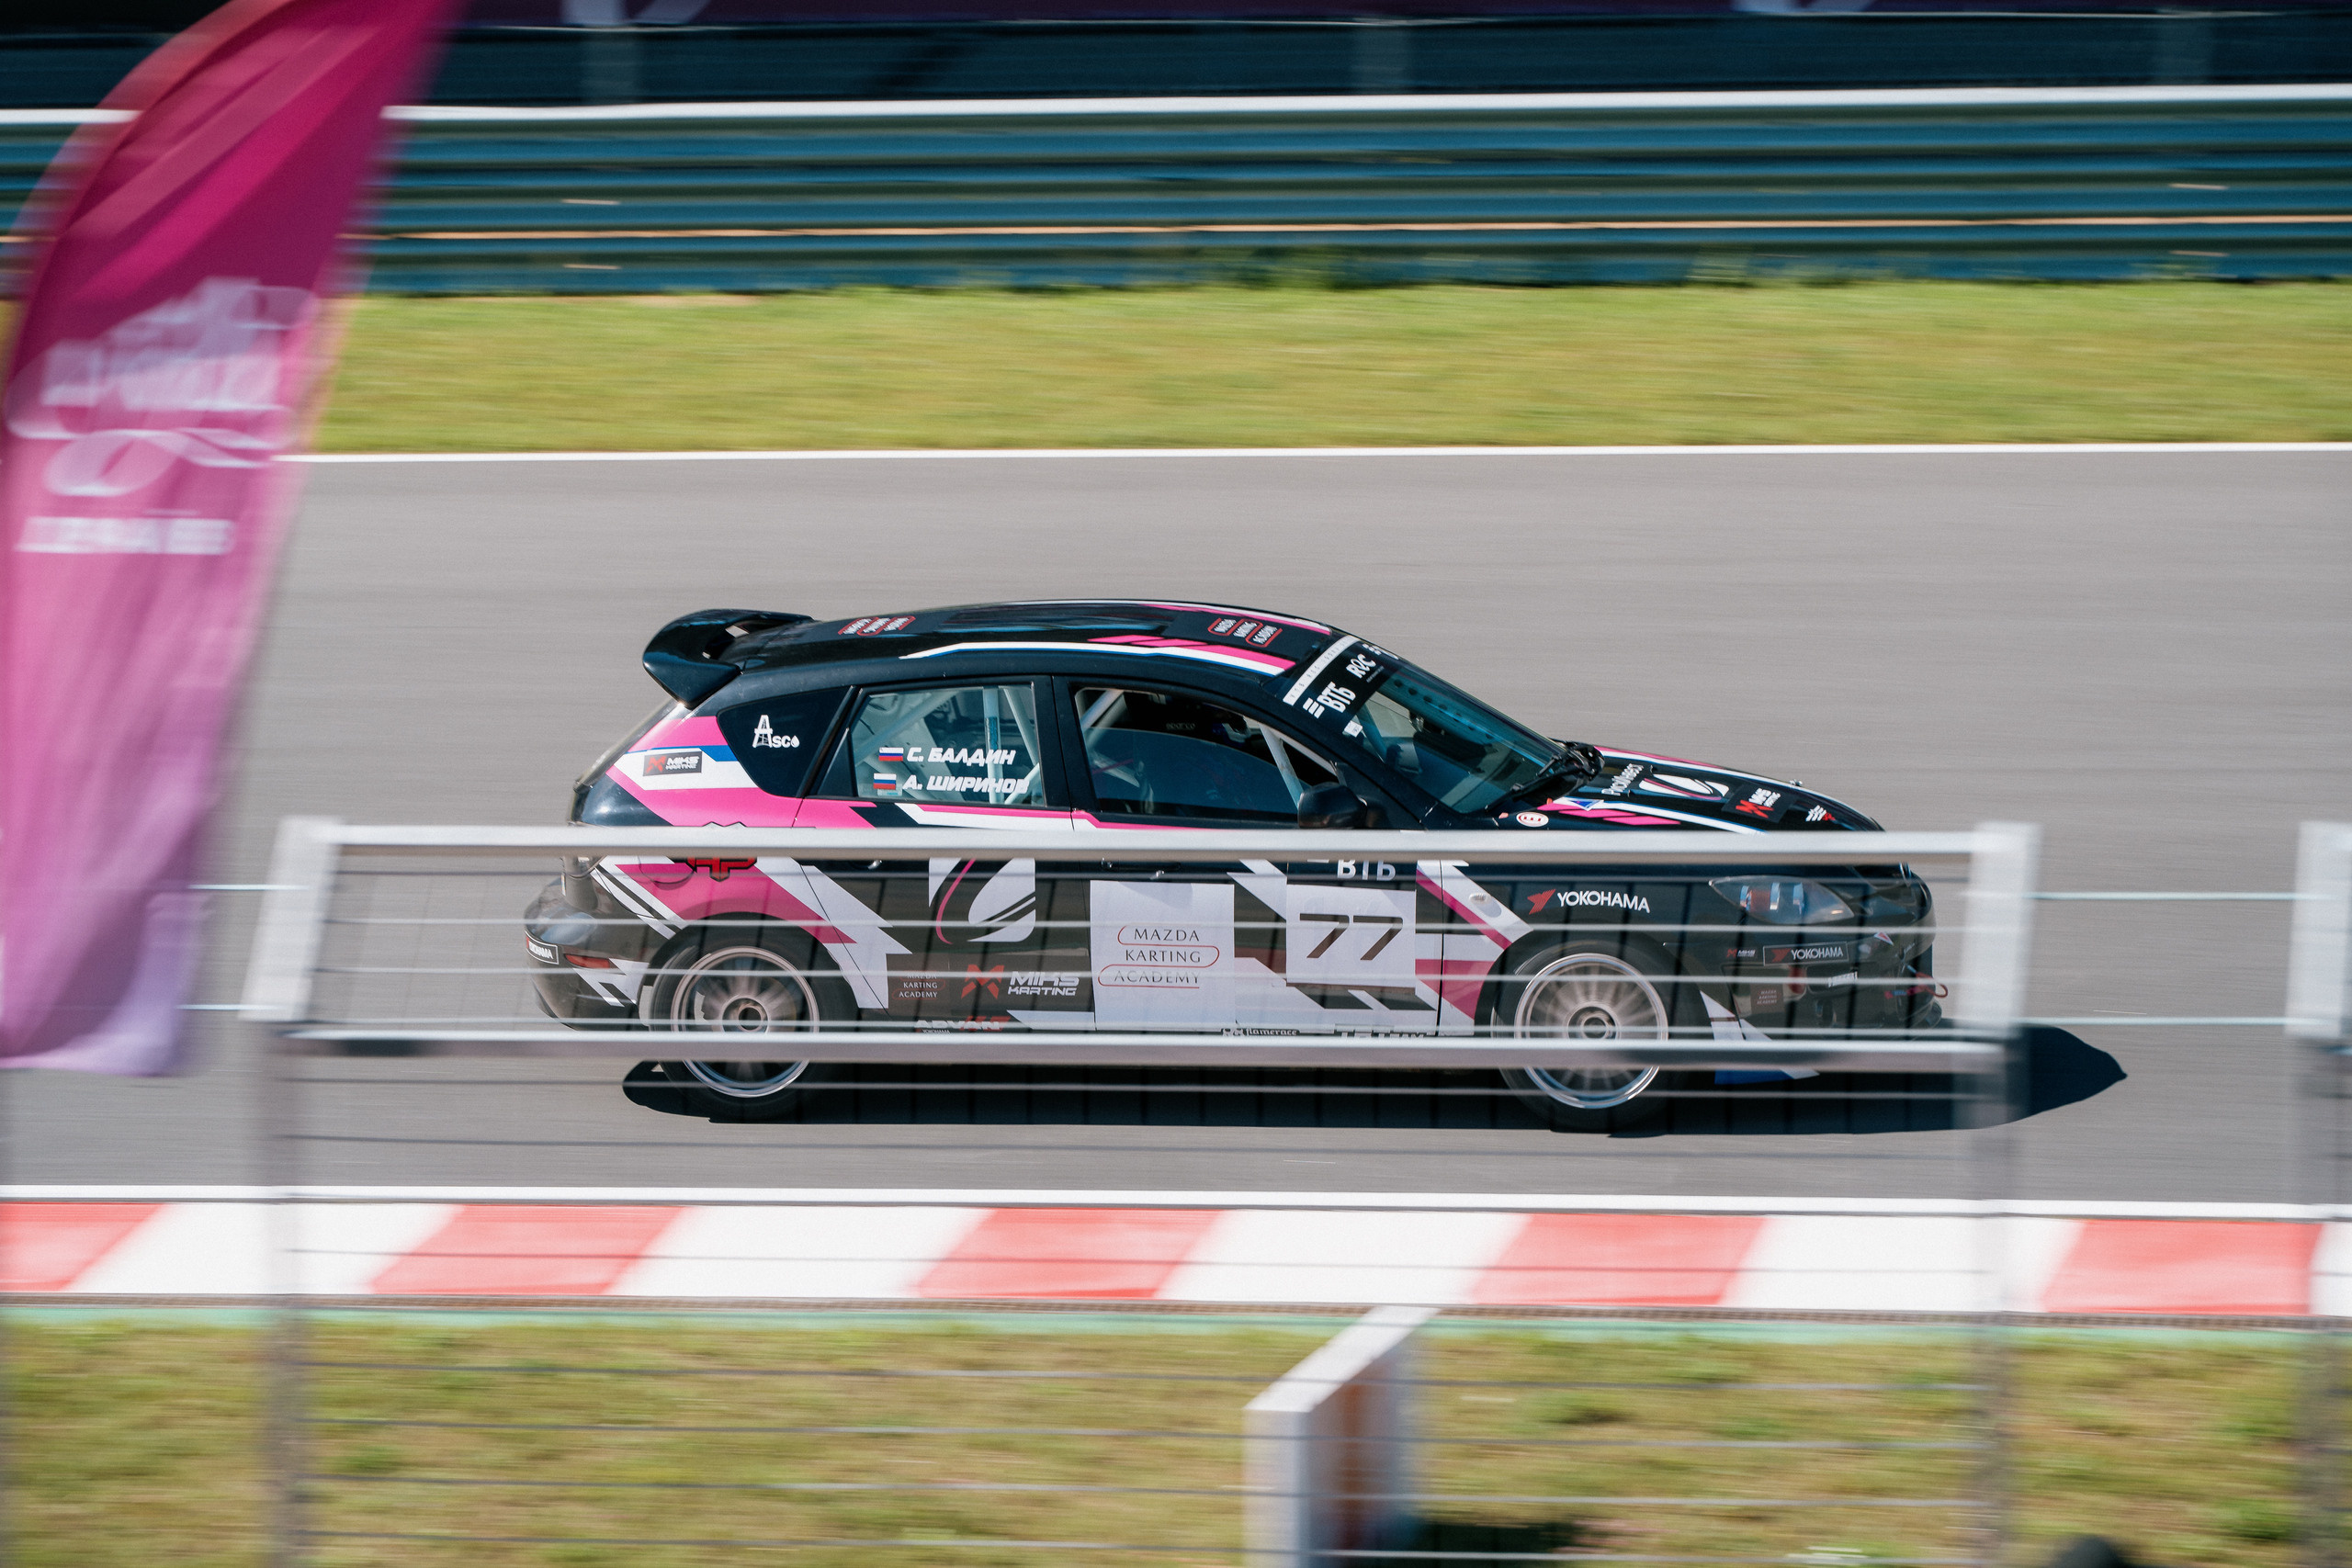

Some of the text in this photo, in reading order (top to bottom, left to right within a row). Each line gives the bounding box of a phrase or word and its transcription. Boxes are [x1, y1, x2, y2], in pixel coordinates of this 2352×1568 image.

[927, 747, 1016, 767] БАЛДИН
[926, 775, 1030, 795] ШИРИНОВ
[1557, 890, 1651, 914] YOKOHAMA
[1134, 928, 1200, 942] MAZDA
[1299, 913, 1404, 961] 77
[1125, 949, 1201, 964] KARTING
[1792, 946, 1844, 960] YOKOHAMA
[903, 981, 938, 989] KARTING
[1114, 970, 1200, 985] ACADEMY
[1007, 986, 1078, 997] KARTING
